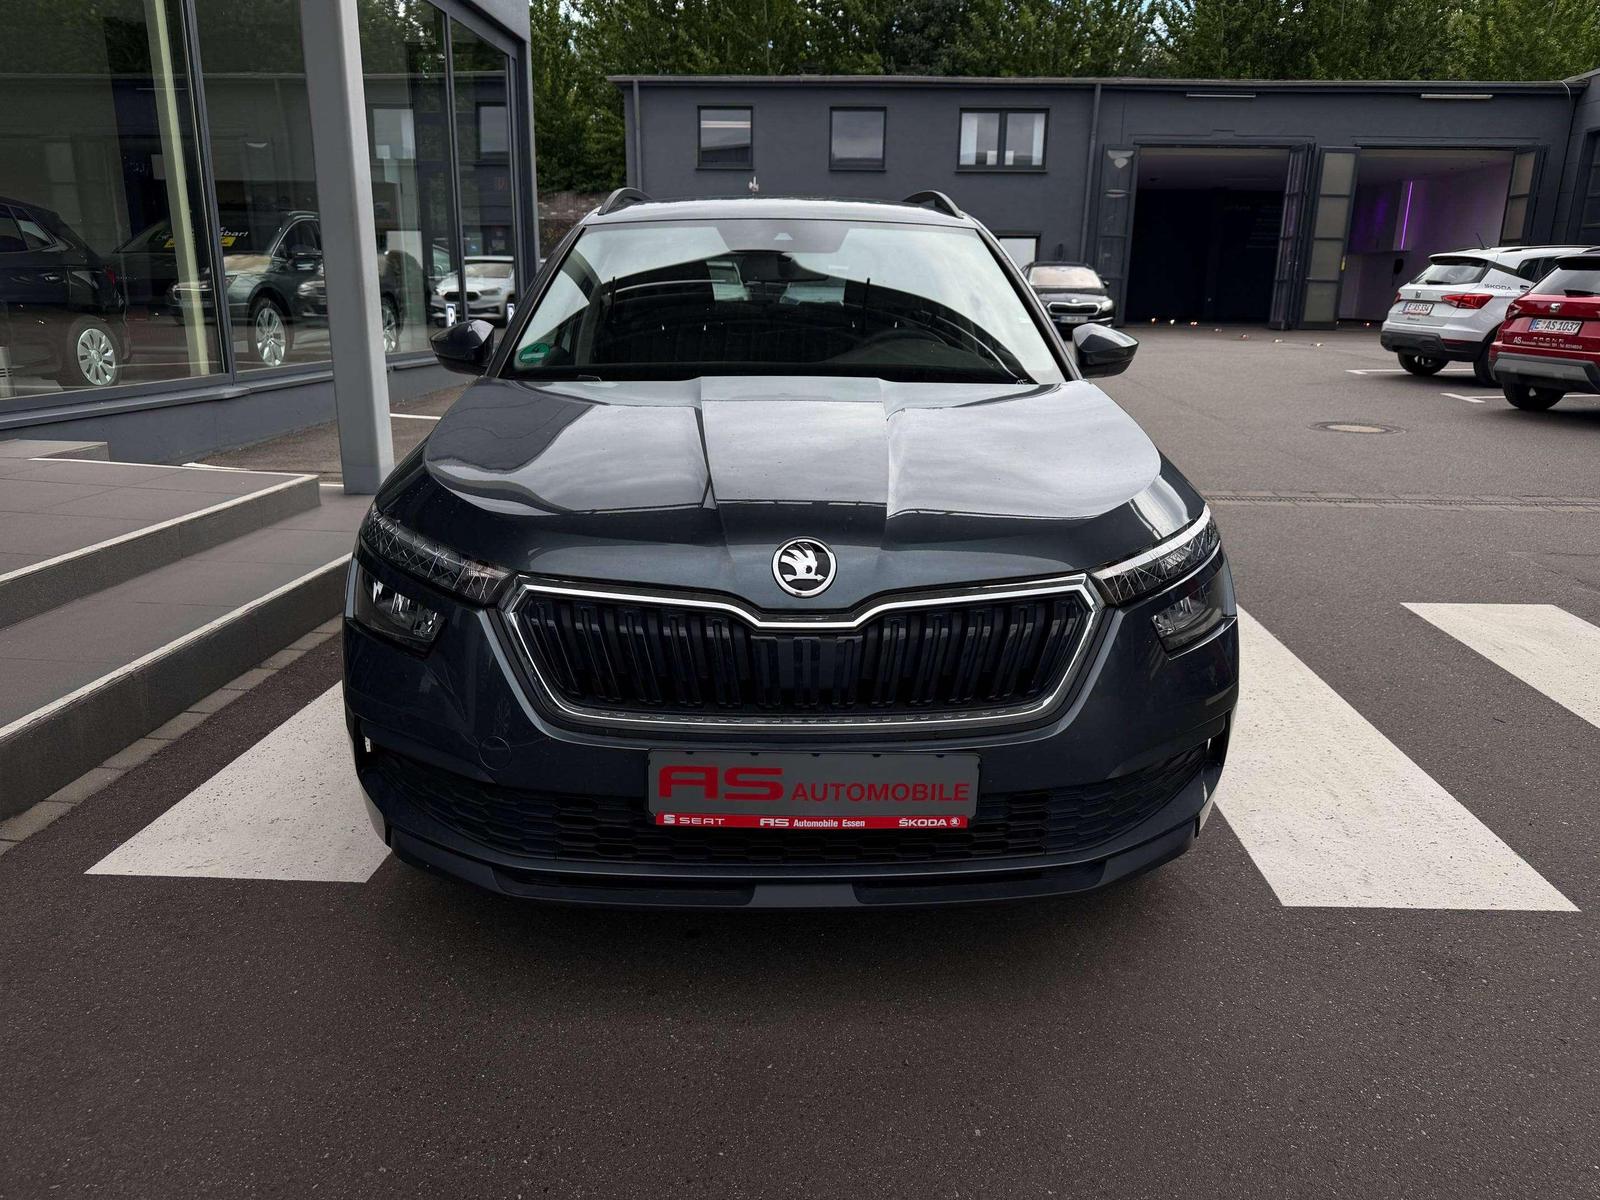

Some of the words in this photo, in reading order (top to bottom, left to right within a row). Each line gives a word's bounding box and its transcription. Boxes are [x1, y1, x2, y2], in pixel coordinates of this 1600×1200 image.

[658, 765, 784, 801] AS
[791, 782, 969, 802] AUTOMOBILE
[679, 817, 726, 825] SEAT
[759, 818, 789, 827] AS
[793, 819, 838, 828] Automobile
[842, 819, 865, 828] Essen
[898, 817, 947, 827] ŠKODA
